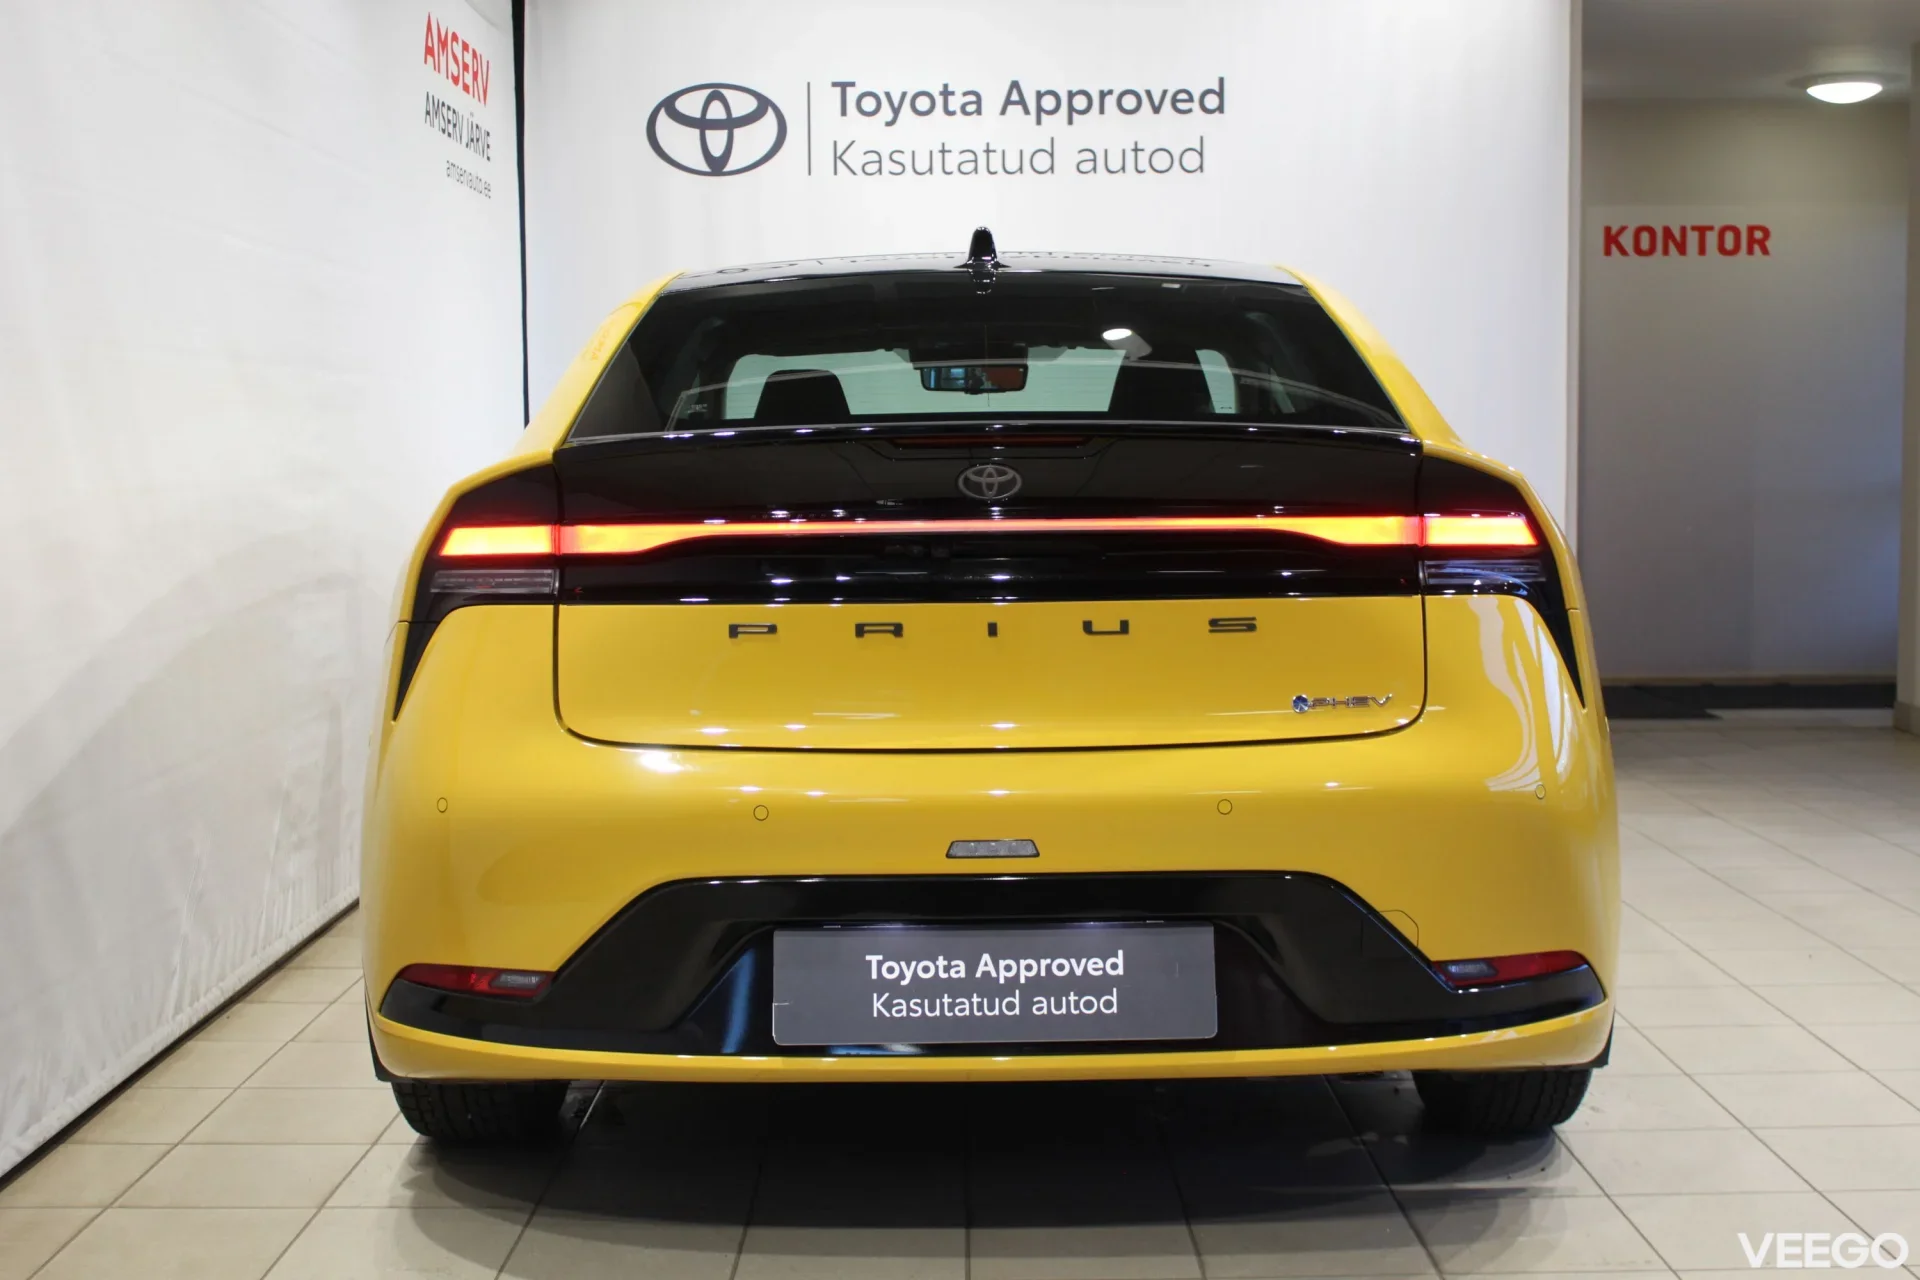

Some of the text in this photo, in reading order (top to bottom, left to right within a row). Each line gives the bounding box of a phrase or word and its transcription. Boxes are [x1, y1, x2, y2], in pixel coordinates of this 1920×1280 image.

[424, 12, 490, 107] AMSERV
[831, 77, 1225, 126] Toyota Approved
[425, 91, 491, 162] AMSERV JÄRVE
[833, 136, 1204, 176] Kasutatud autod
[446, 160, 491, 199] amservauto.ee
[1603, 224, 1772, 257] KONTOR
[728, 616, 1258, 638] PRIUS
[865, 950, 1124, 985] Toyota Approved
[872, 988, 1118, 1018] Kasutatud autod
